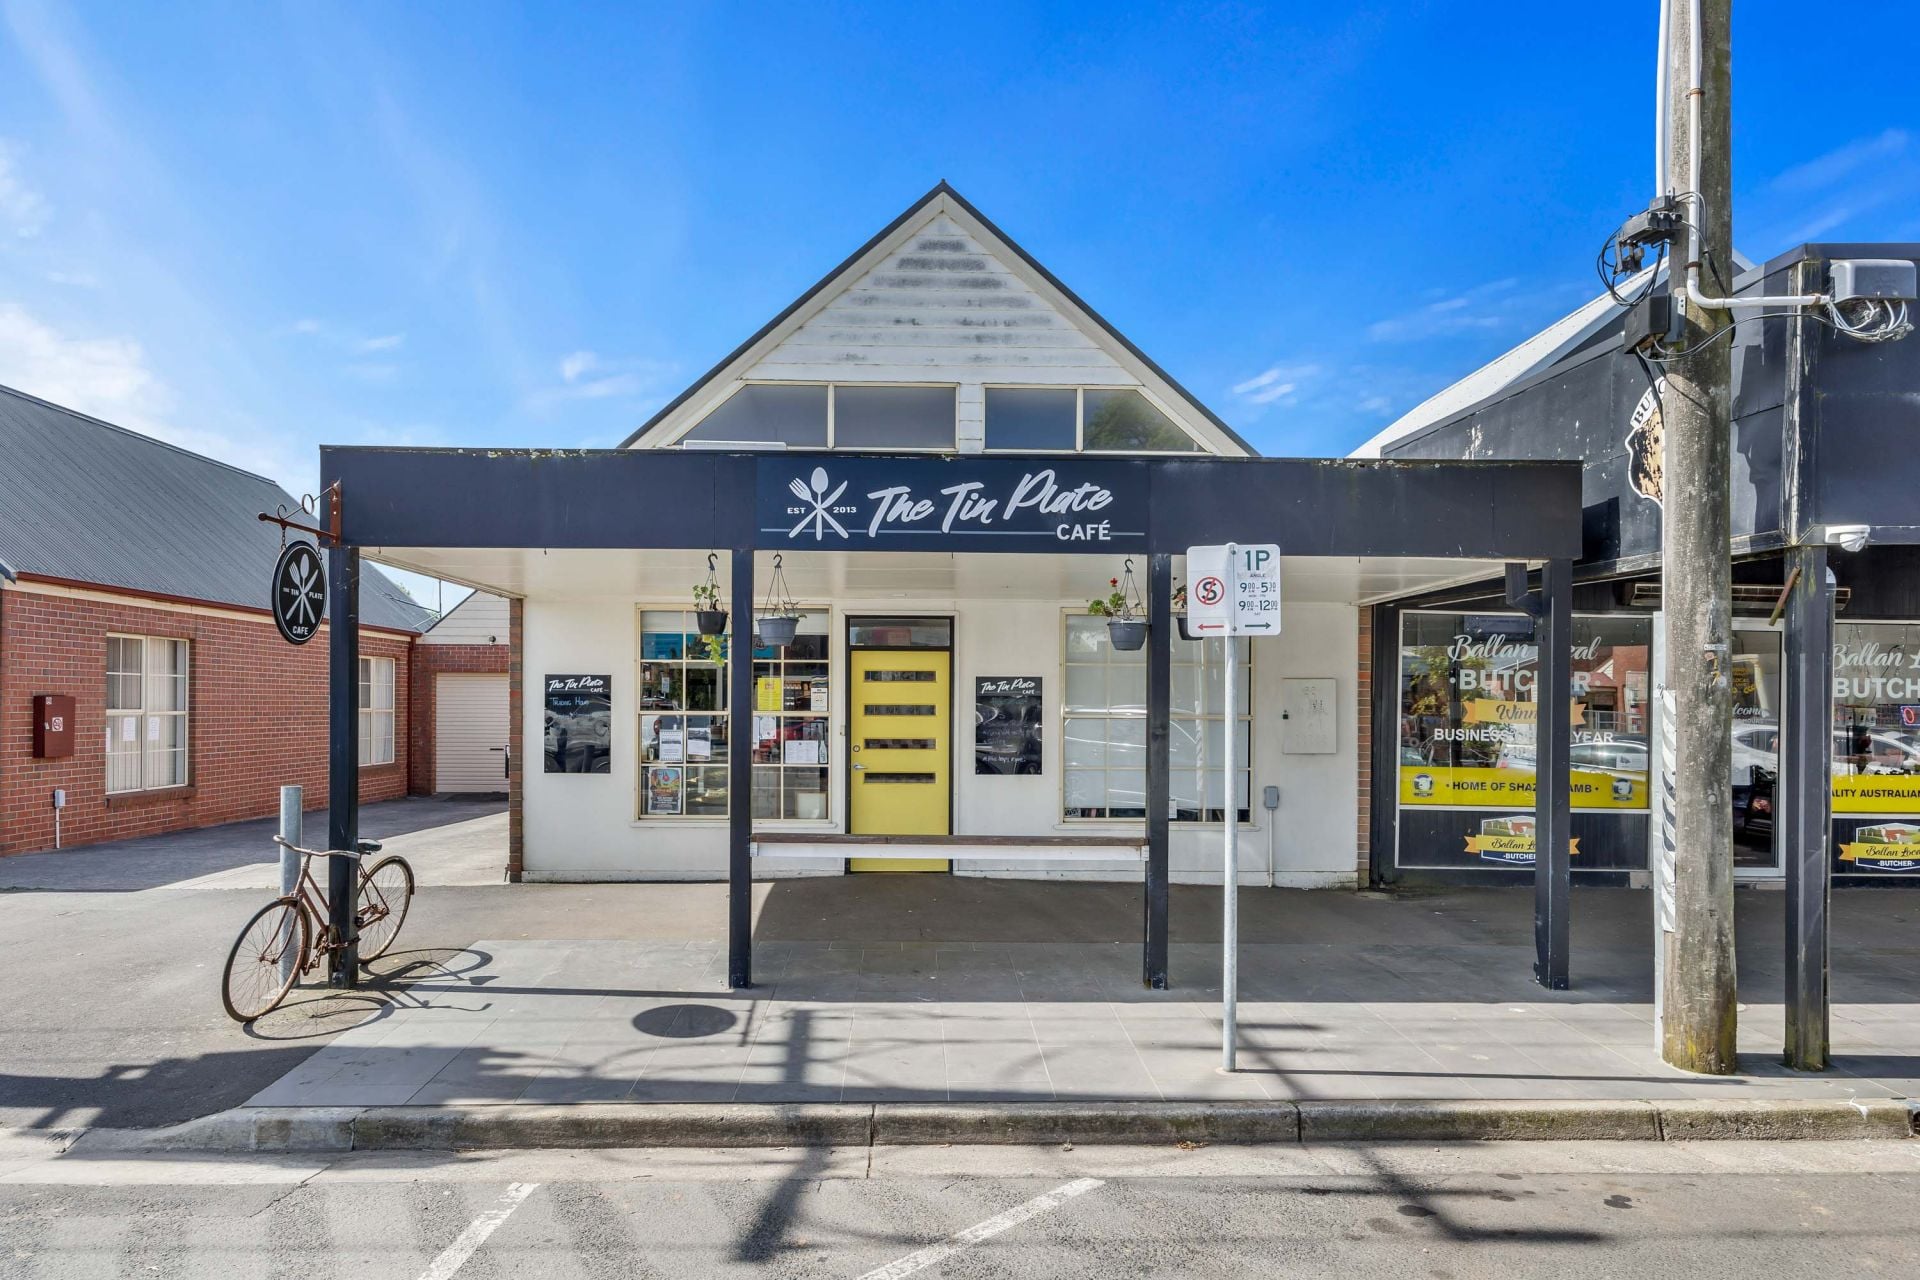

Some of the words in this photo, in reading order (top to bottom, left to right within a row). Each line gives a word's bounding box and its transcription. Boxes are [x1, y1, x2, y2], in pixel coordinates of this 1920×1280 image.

[867, 486, 935, 538] The
[941, 481, 998, 534] Tin
[1003, 469, 1113, 520] Plate
[787, 507, 806, 515] EST
[832, 506, 857, 514] 2013
[1056, 520, 1111, 541] CAFÉ
[1245, 550, 1270, 571] 1P
[290, 588, 300, 596] TIN
[309, 591, 324, 600] PLATE
[292, 625, 309, 635] CAFE
[1447, 633, 1529, 662] Ballan
[1834, 642, 1904, 669] Ballan
[1834, 677, 1920, 699] BUTCH
[1572, 731, 1614, 743] YEAR
[1453, 781, 1487, 791] HOME
[1491, 782, 1506, 791] OF
[1491, 838, 1524, 849] Ballan
[1866, 845, 1899, 857] Ballan
[1901, 847, 1920, 858] Loca
